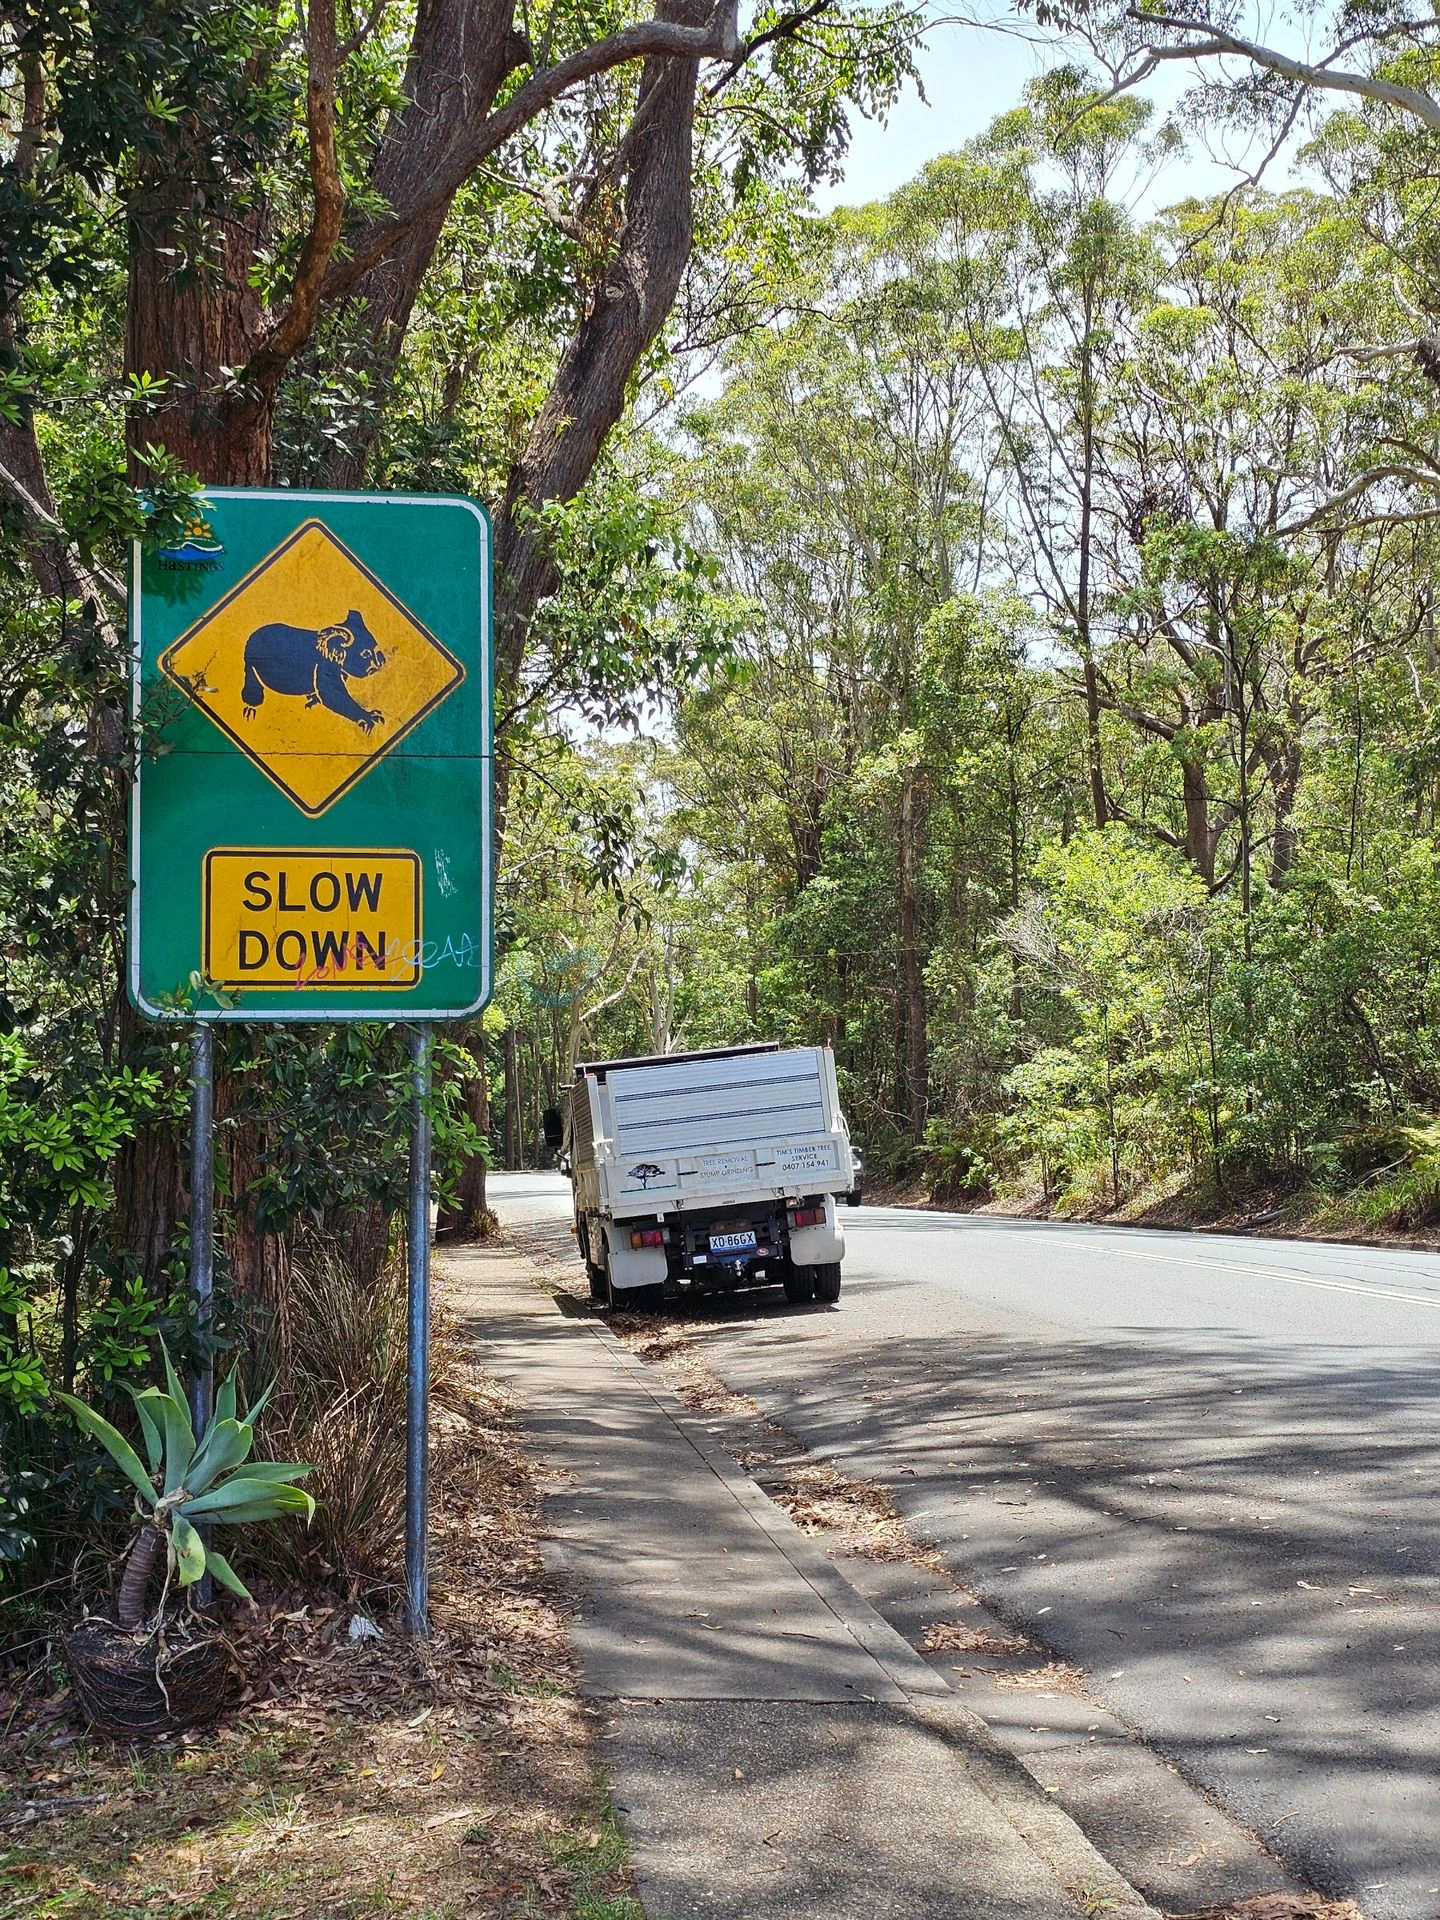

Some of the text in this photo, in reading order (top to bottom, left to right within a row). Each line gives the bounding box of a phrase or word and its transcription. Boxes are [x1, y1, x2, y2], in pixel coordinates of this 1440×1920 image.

[242, 871, 383, 913] SLOW
[239, 929, 386, 972] DOWN
[776, 1148, 792, 1156] TIM'S
[794, 1146, 816, 1154] TIMBER
[703, 1155, 749, 1167] TREE REMOVAL
[792, 1153, 817, 1162] SERVICE
[782, 1159, 829, 1171] 0407 154 941
[700, 1166, 754, 1178] STUMP GRINDING
